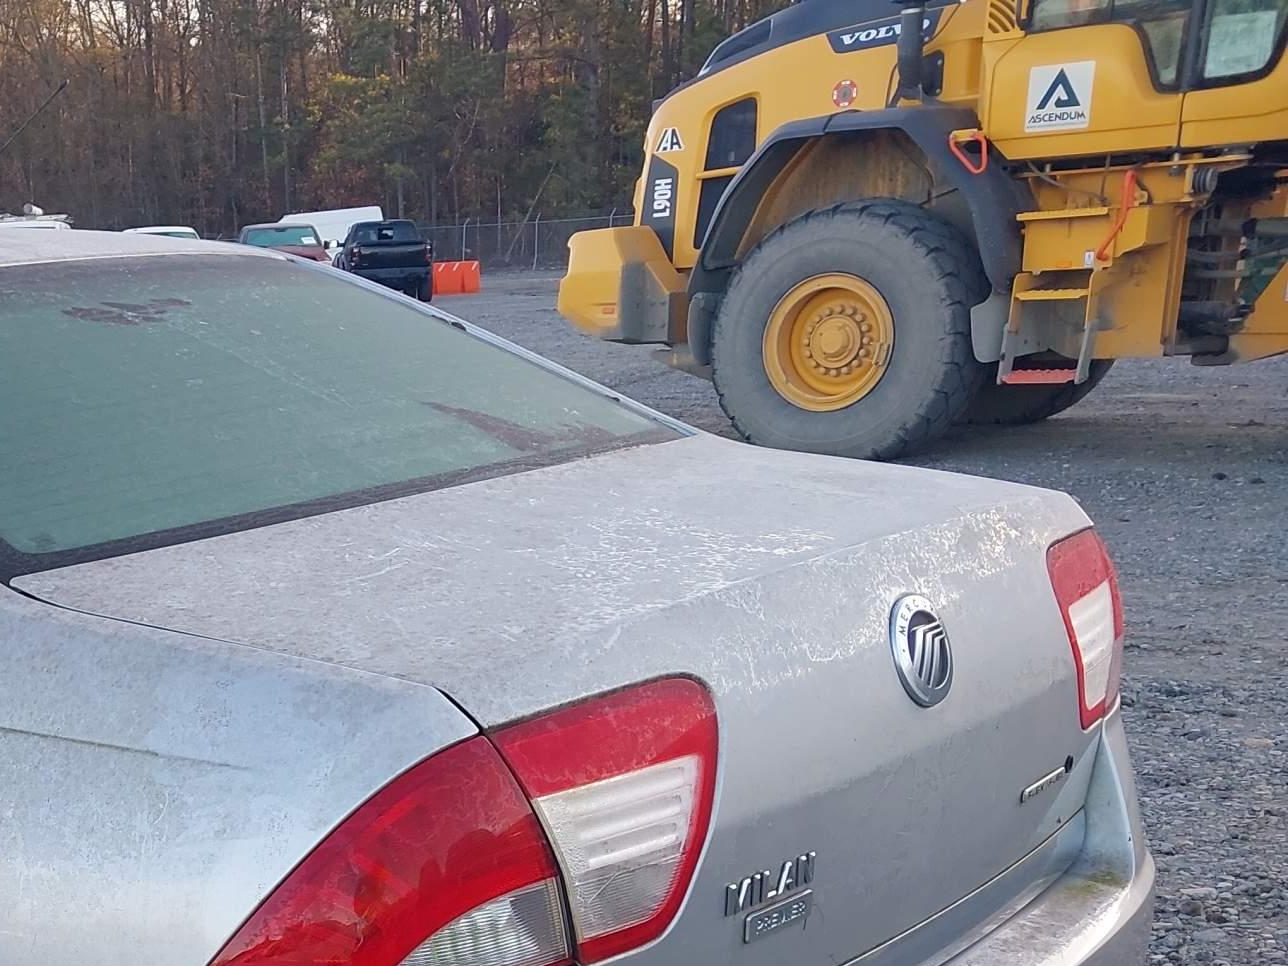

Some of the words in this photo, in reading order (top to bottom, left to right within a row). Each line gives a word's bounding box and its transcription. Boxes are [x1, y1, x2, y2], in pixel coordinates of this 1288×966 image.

[1027, 110, 1086, 124] ASCENDUM
[652, 178, 673, 218] L90H
[724, 851, 817, 917] MILAN
